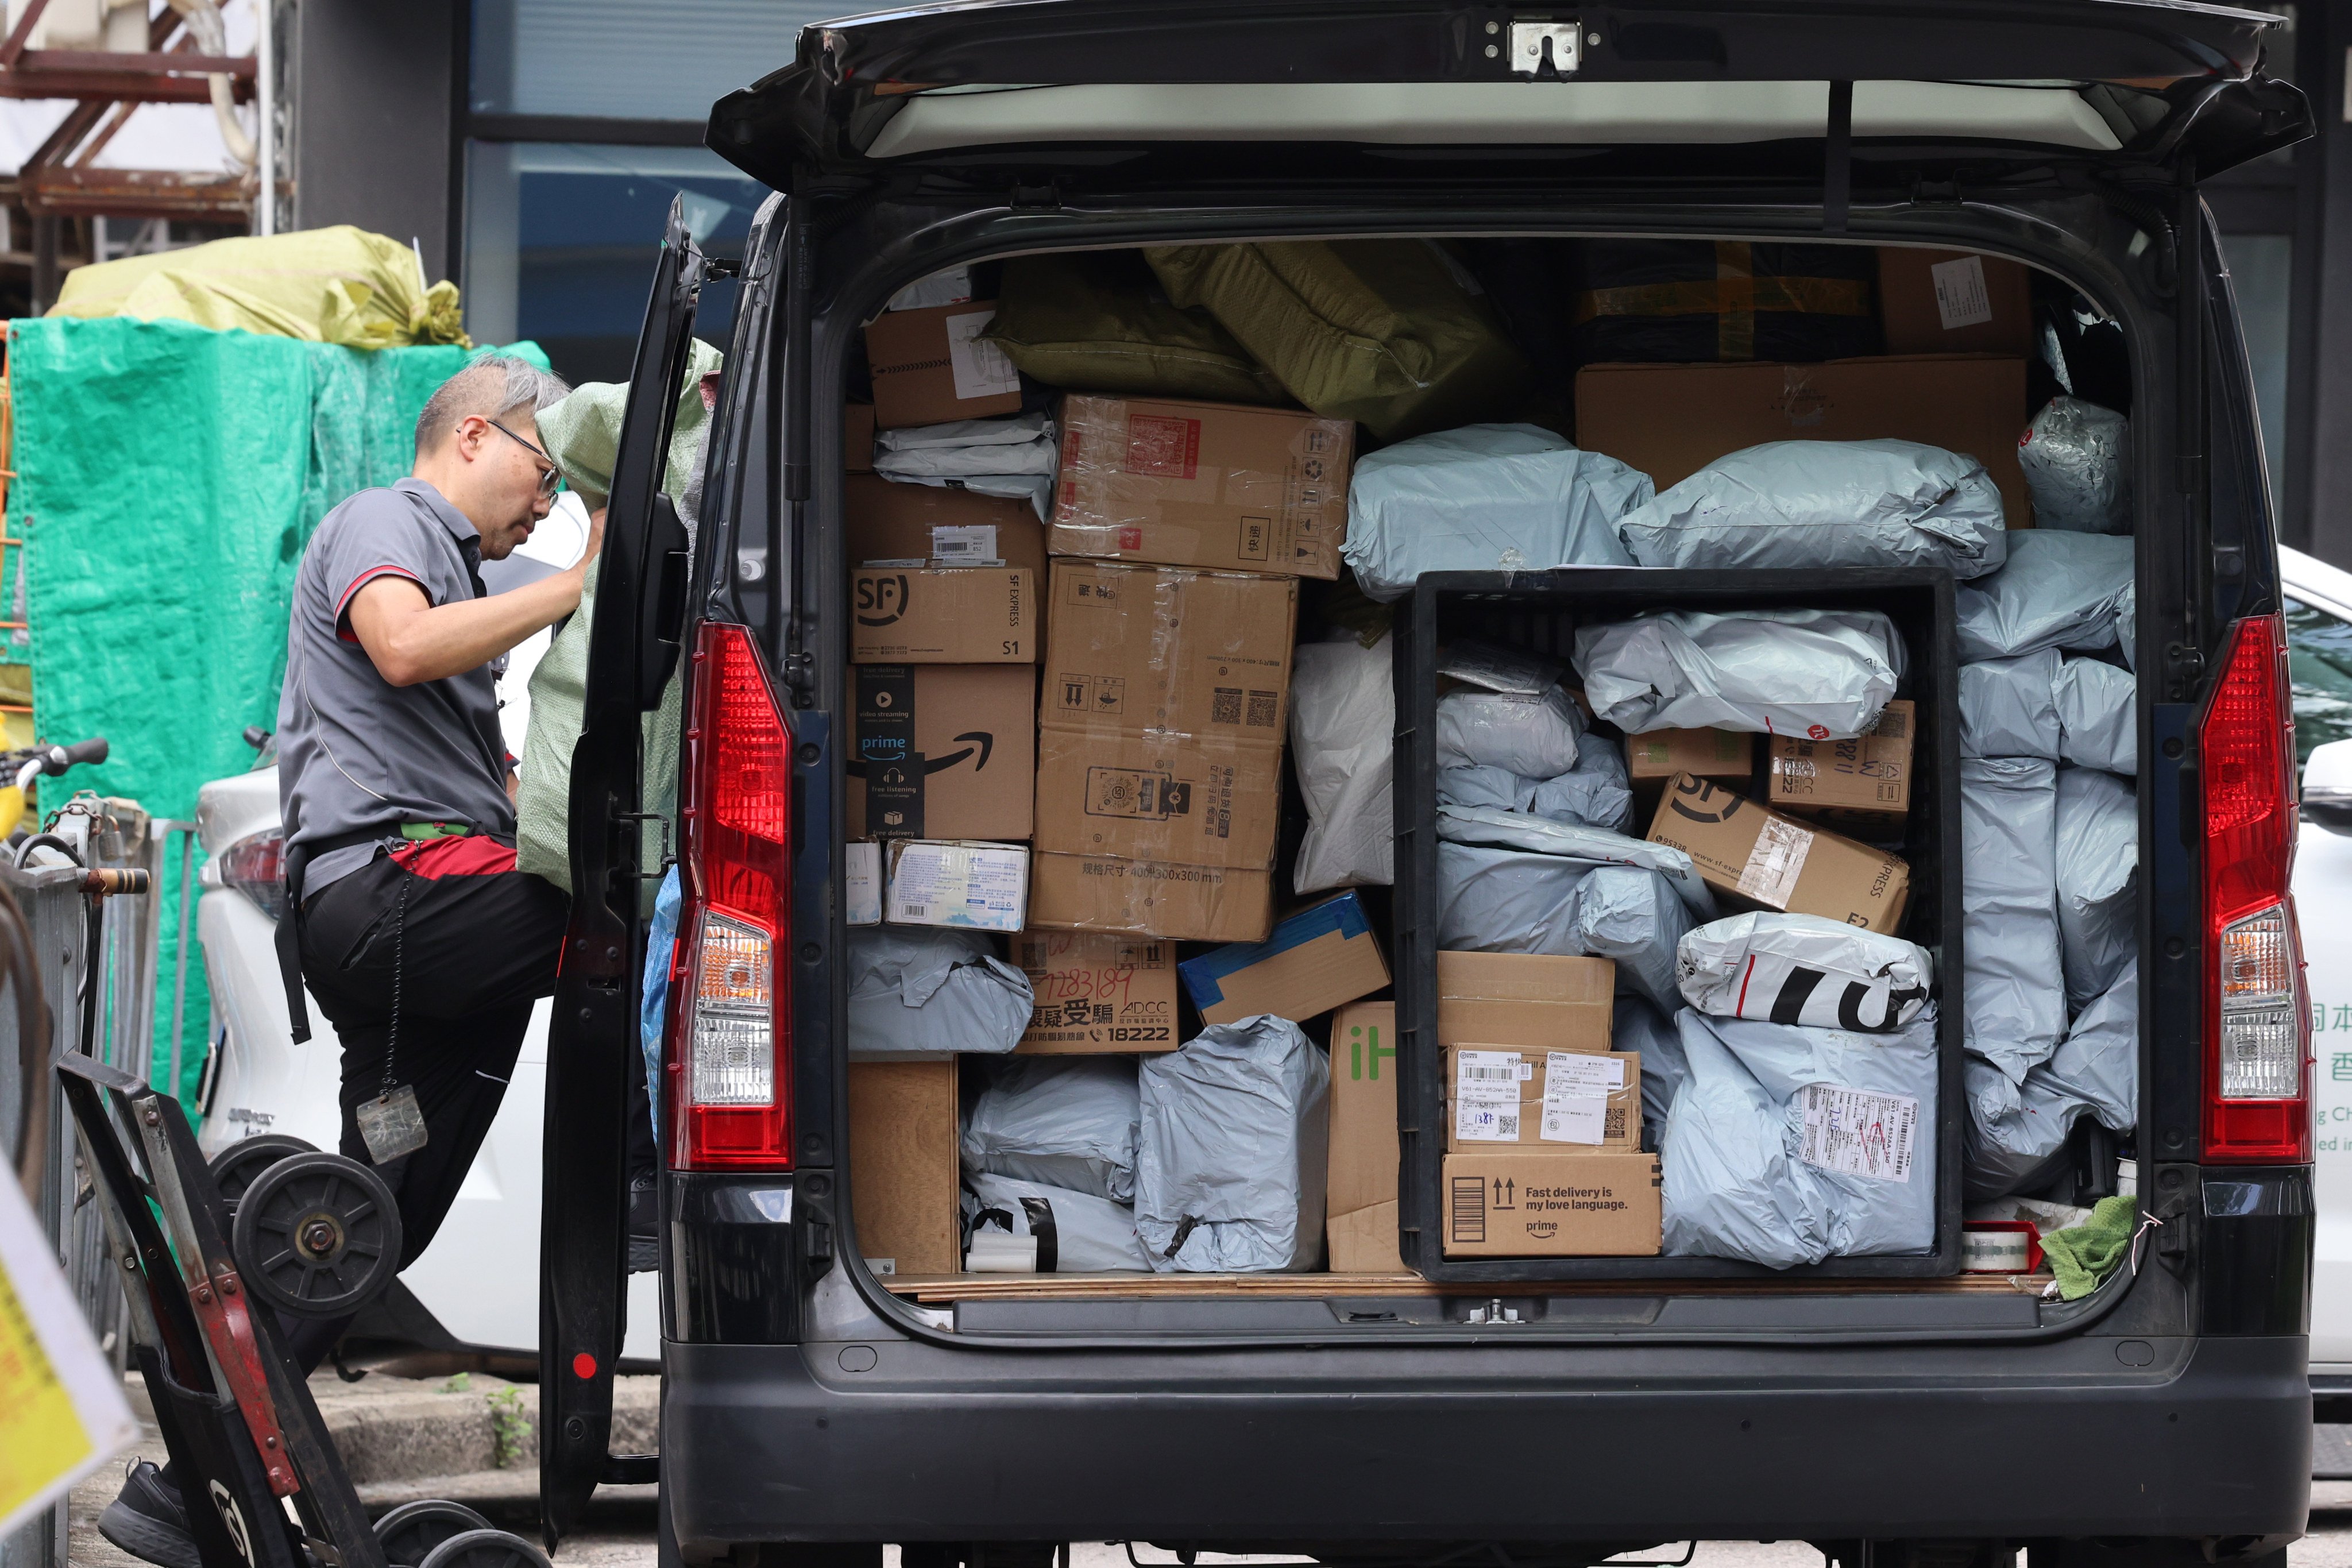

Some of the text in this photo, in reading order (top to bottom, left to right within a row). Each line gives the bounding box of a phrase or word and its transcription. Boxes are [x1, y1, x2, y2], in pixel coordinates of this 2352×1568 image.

[1249, 526, 1261, 552] 快递
[858, 578, 895, 609] SF
[1010, 575, 1019, 627] SF EXPRESS
[1002, 641, 1019, 655] S1
[878, 666, 905, 674] delivery
[862, 735, 906, 751] prime
[887, 786, 917, 794] listening
[888, 829, 914, 837] delivery
[1662, 837, 1687, 853] 95338
[1082, 862, 1125, 878] 规格尺寸
[1120, 1001, 1167, 1015] ADCC
[1107, 1027, 1169, 1041] 18222
[1507, 1057, 1521, 1067] 特快
[1886, 1100, 1897, 1164] V61-AV-852AA-550
[1525, 1187, 1612, 1199] Fast delivery is
[1525, 1200, 1628, 1212] my love language.
[1526, 1221, 1558, 1233] prime
